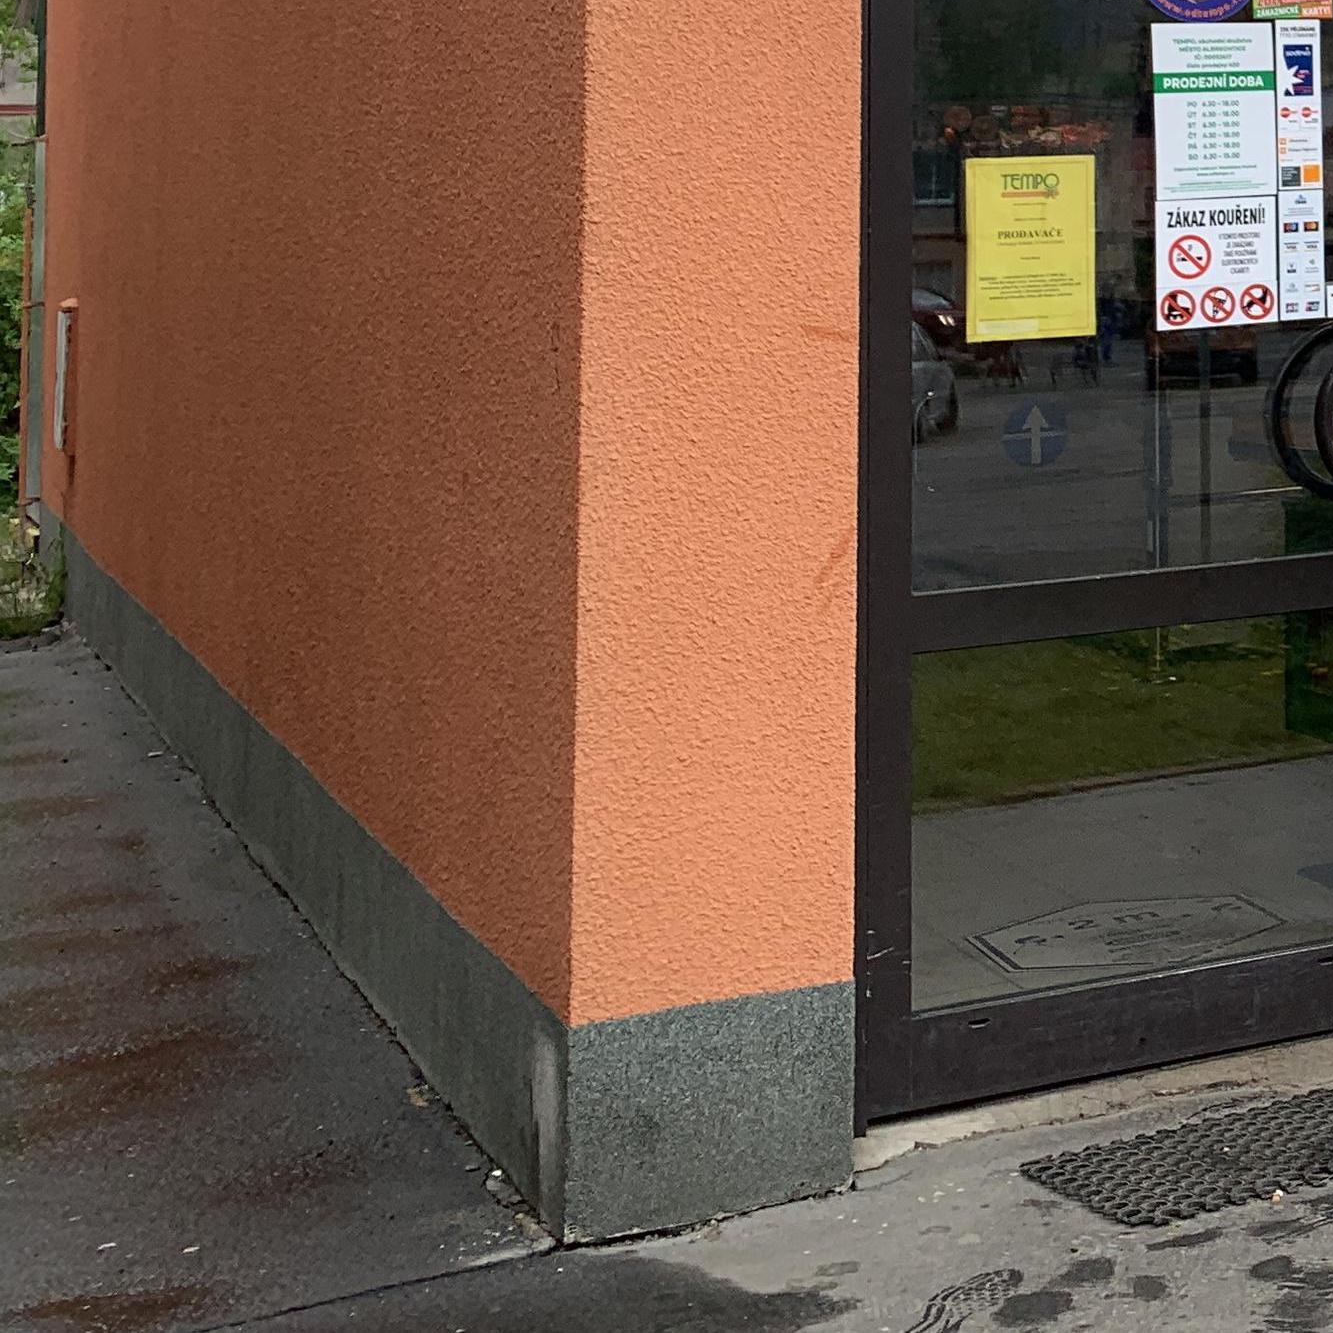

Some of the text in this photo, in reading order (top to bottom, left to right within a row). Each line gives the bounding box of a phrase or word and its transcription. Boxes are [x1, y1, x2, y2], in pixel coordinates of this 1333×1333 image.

[1163, 73, 1227, 89] PRODEJNÍ
[1229, 75, 1264, 88] DOBA
[1001, 173, 1060, 190] TEMPO
[1167, 207, 1206, 228] ZÁKAZ
[1209, 203, 1266, 226] KOUŘENÍ!
[997, 228, 1064, 240] PRODAVAČE
